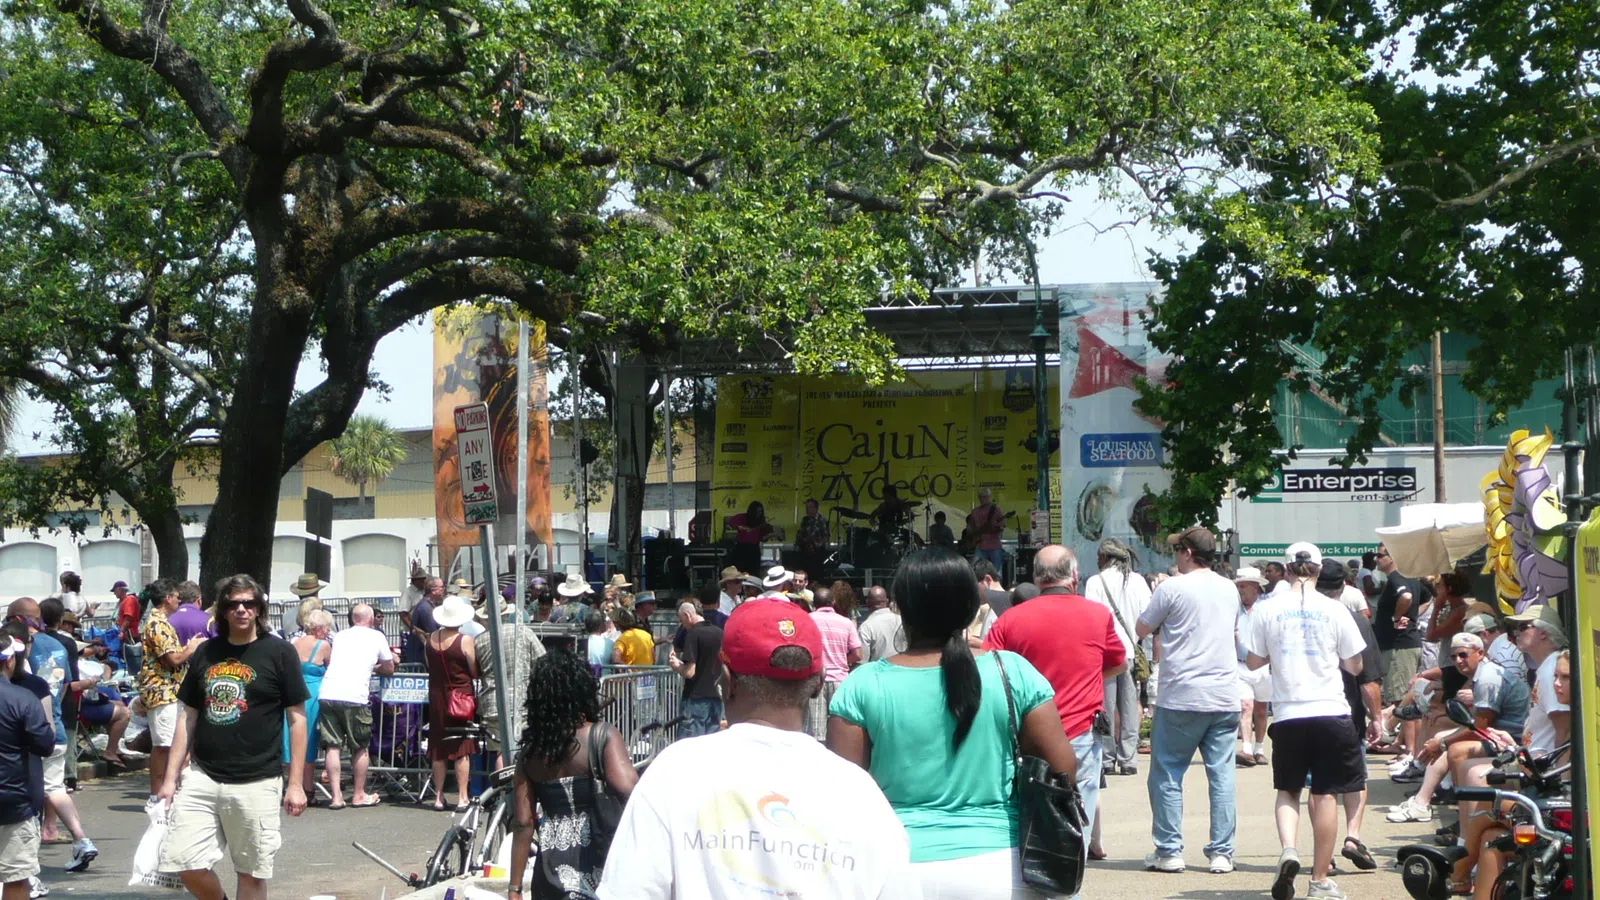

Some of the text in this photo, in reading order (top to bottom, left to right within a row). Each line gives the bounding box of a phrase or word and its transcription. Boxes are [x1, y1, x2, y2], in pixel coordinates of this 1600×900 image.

[464, 438, 484, 456] ANY
[1087, 440, 1153, 451] LOUISIANA
[1090, 449, 1156, 462] SEAFOOD
[464, 463, 488, 481] TE
[1284, 471, 1415, 492] Enterprise
[683, 829, 856, 872] MainFunction
